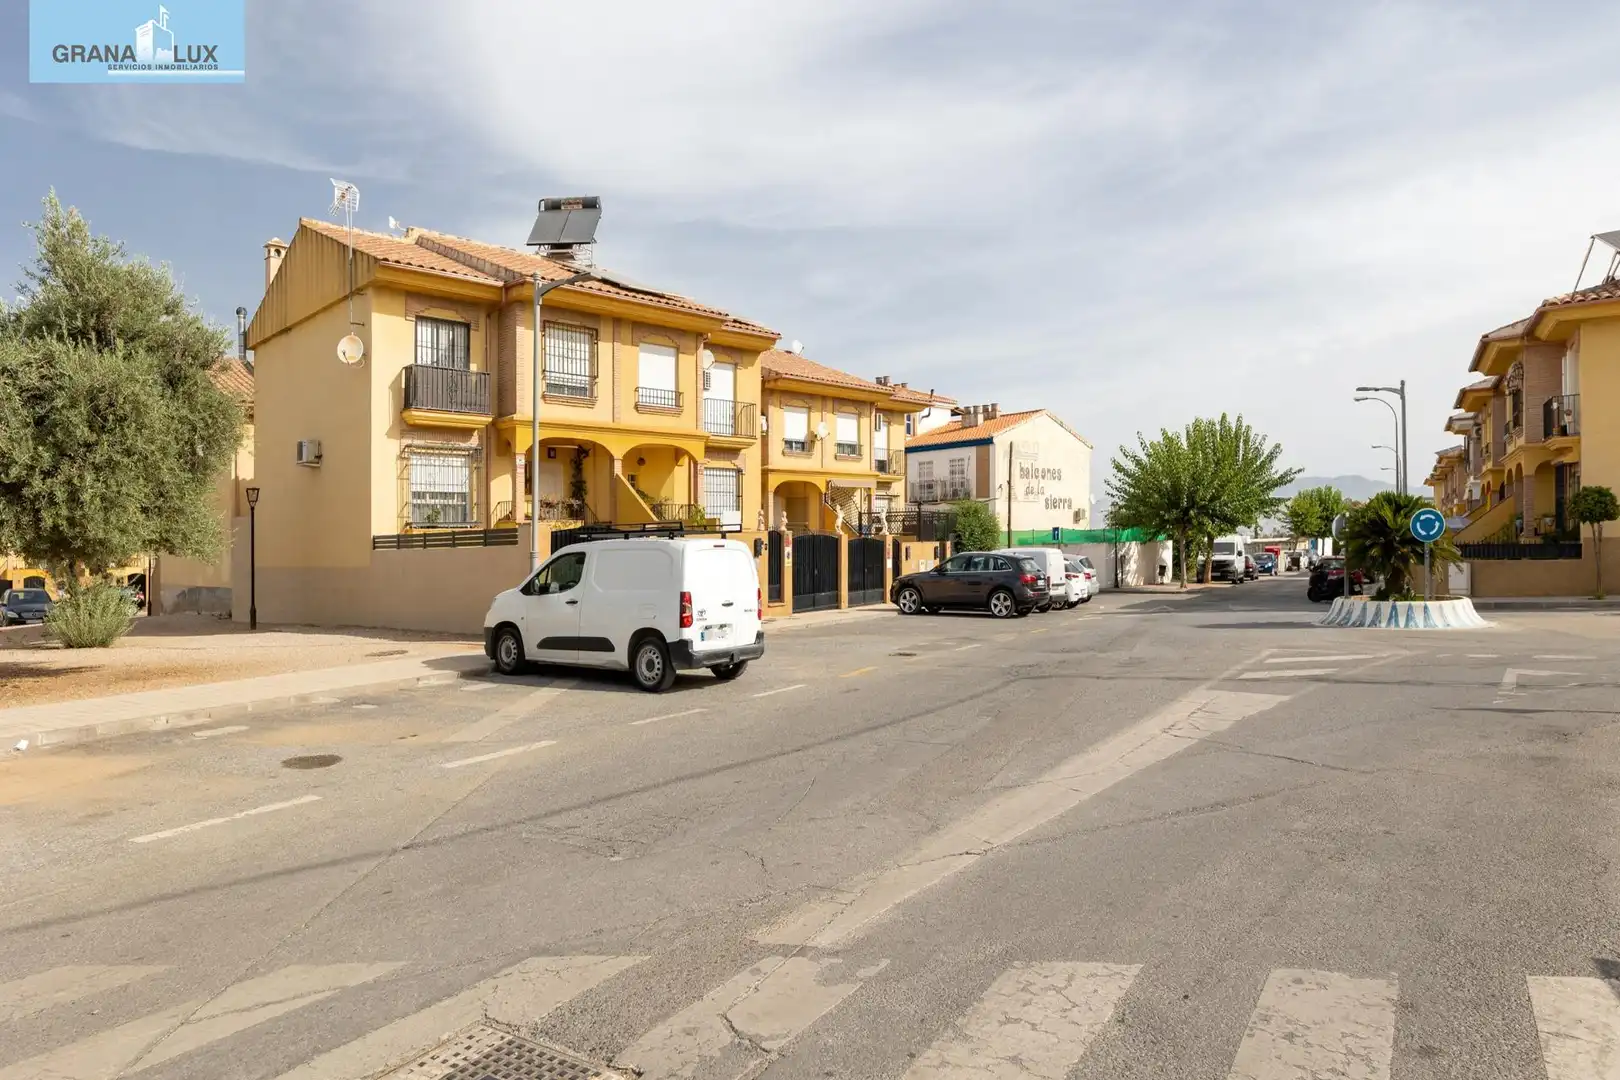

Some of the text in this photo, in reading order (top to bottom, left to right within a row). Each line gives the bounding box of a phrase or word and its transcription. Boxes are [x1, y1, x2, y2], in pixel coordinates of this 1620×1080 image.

[1019, 462, 1062, 481] balcones
[1025, 479, 1045, 495] de la
[1044, 494, 1072, 510] sierra
